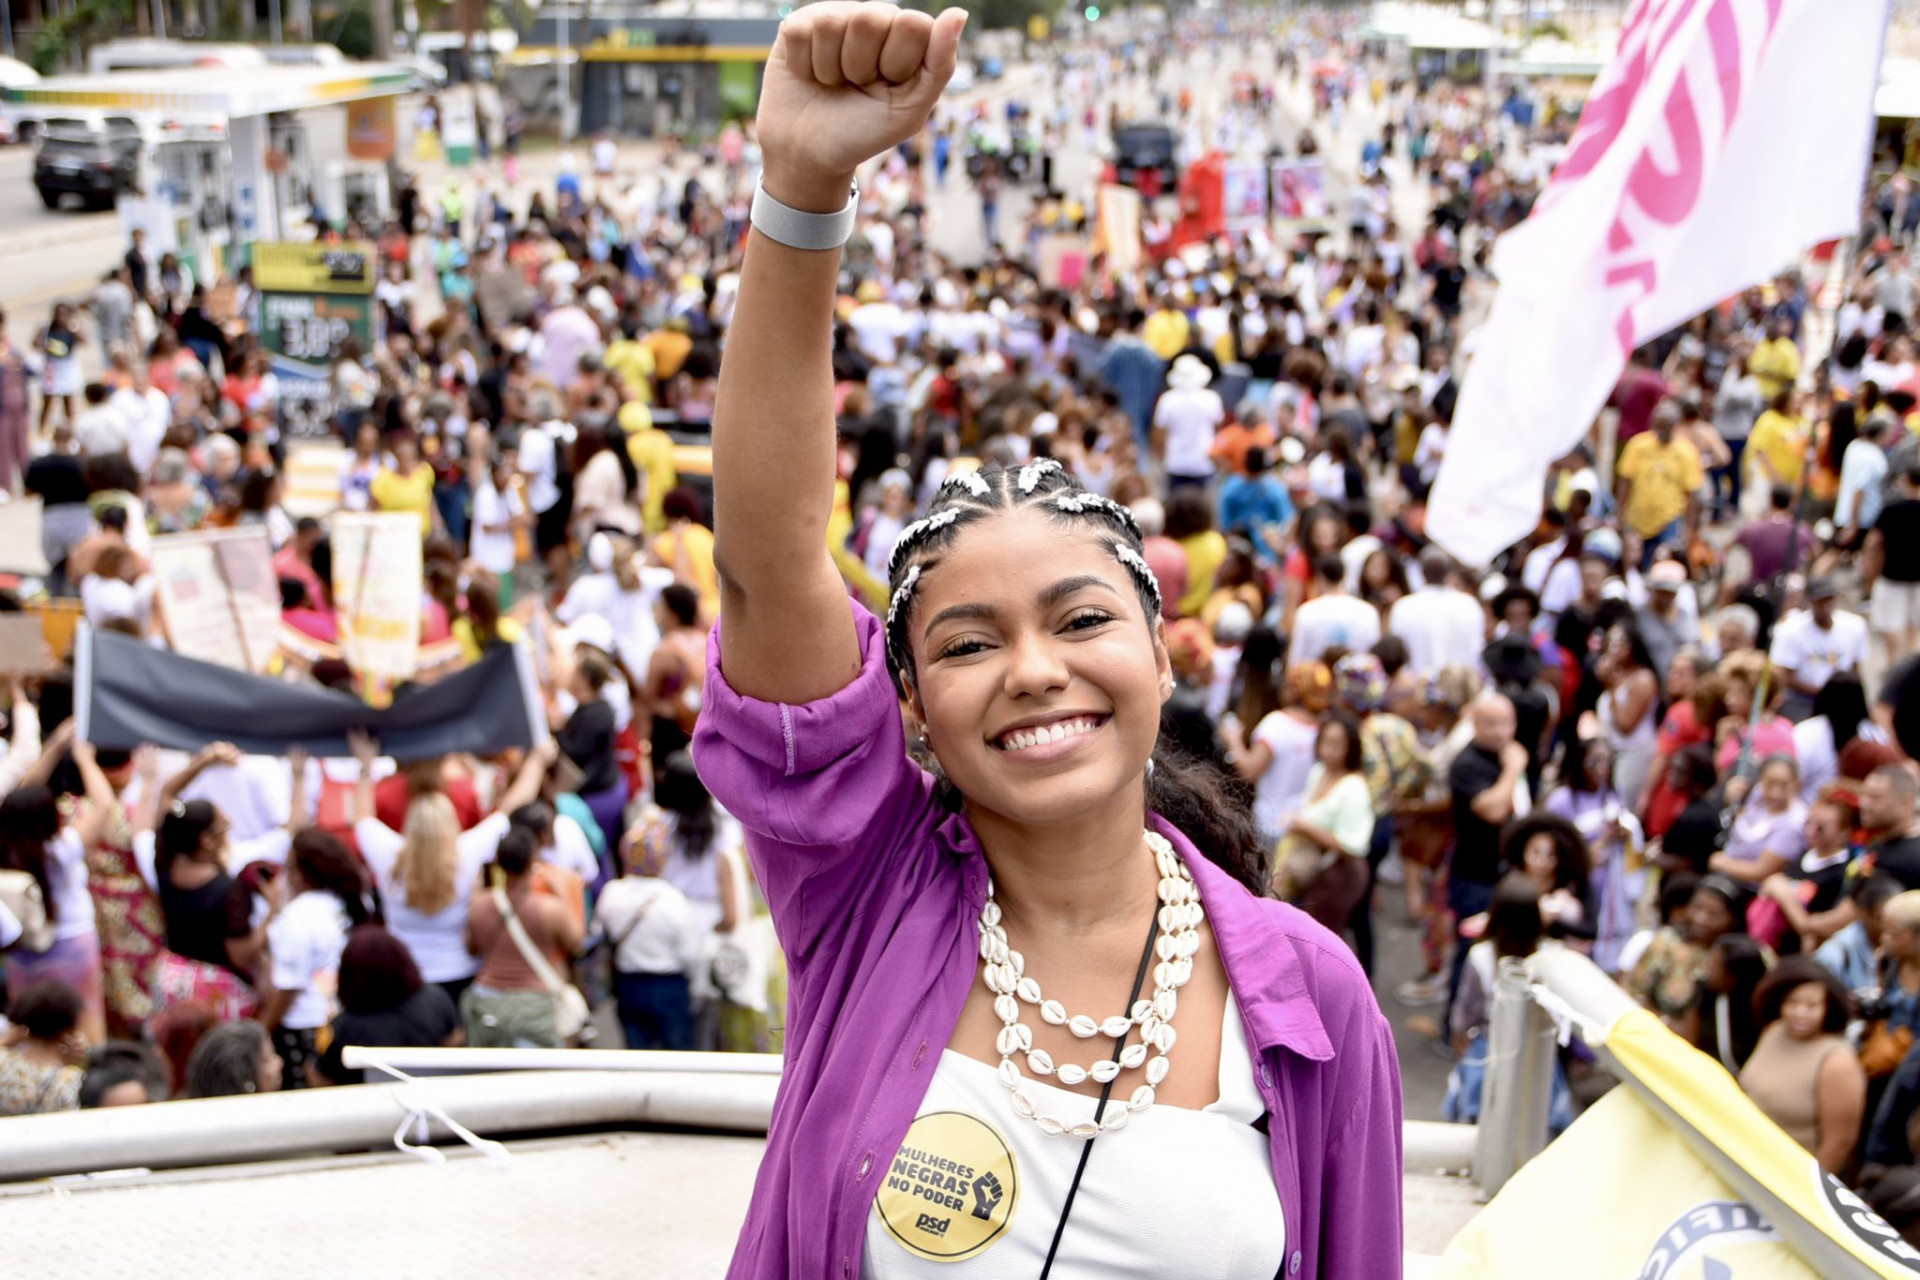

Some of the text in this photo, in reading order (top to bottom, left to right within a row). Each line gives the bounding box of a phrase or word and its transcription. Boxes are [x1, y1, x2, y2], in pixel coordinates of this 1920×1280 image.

[893, 1159, 970, 1195] NEGRAS
[899, 1146, 974, 1178] MULHERES
[889, 1177, 963, 1211] NO PODER
[916, 1214, 950, 1232] psd
